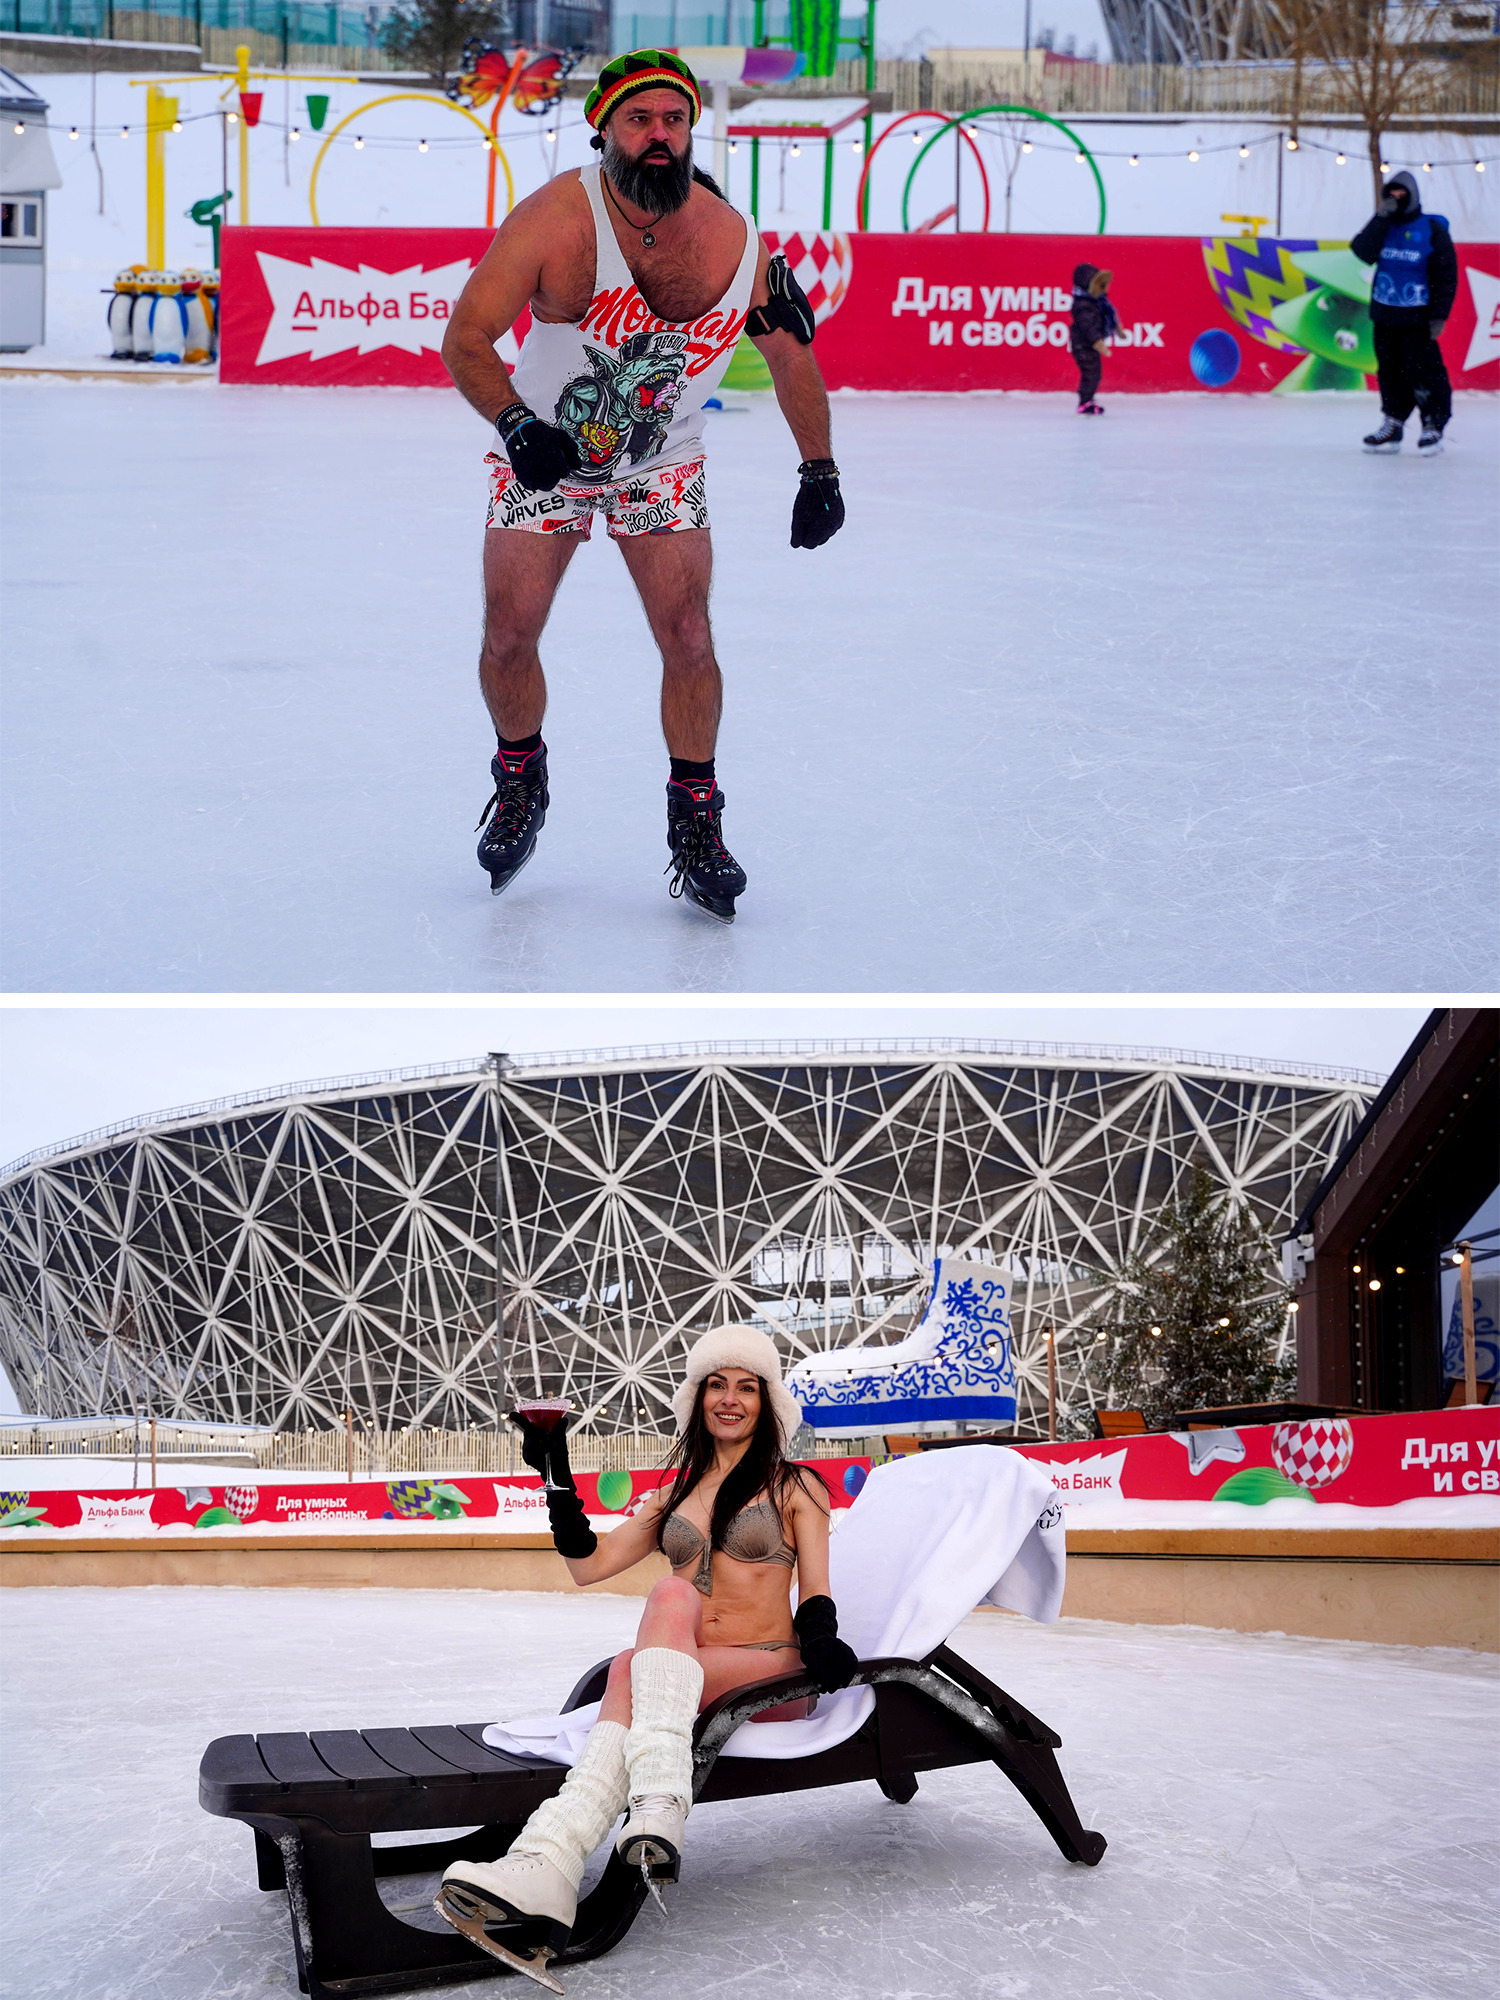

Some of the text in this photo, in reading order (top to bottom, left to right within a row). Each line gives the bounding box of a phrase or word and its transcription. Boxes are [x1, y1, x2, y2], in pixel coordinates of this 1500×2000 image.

[892, 277, 972, 317] Для
[293, 291, 457, 327] Альфа Ба
[929, 321, 954, 346] и
[618, 488, 661, 505] BANG
[501, 495, 565, 527] WAVES
[621, 498, 678, 533] HOOK
[1401, 1437, 1469, 1470] Для
[1073, 1473, 1112, 1489] Банк
[1433, 1471, 1453, 1492] и
[88, 1506, 145, 1519] Альфа Банк
[276, 1496, 347, 1512] Для умных
[504, 1496, 536, 1511] Альфа
[288, 1508, 368, 1521] и свободных
